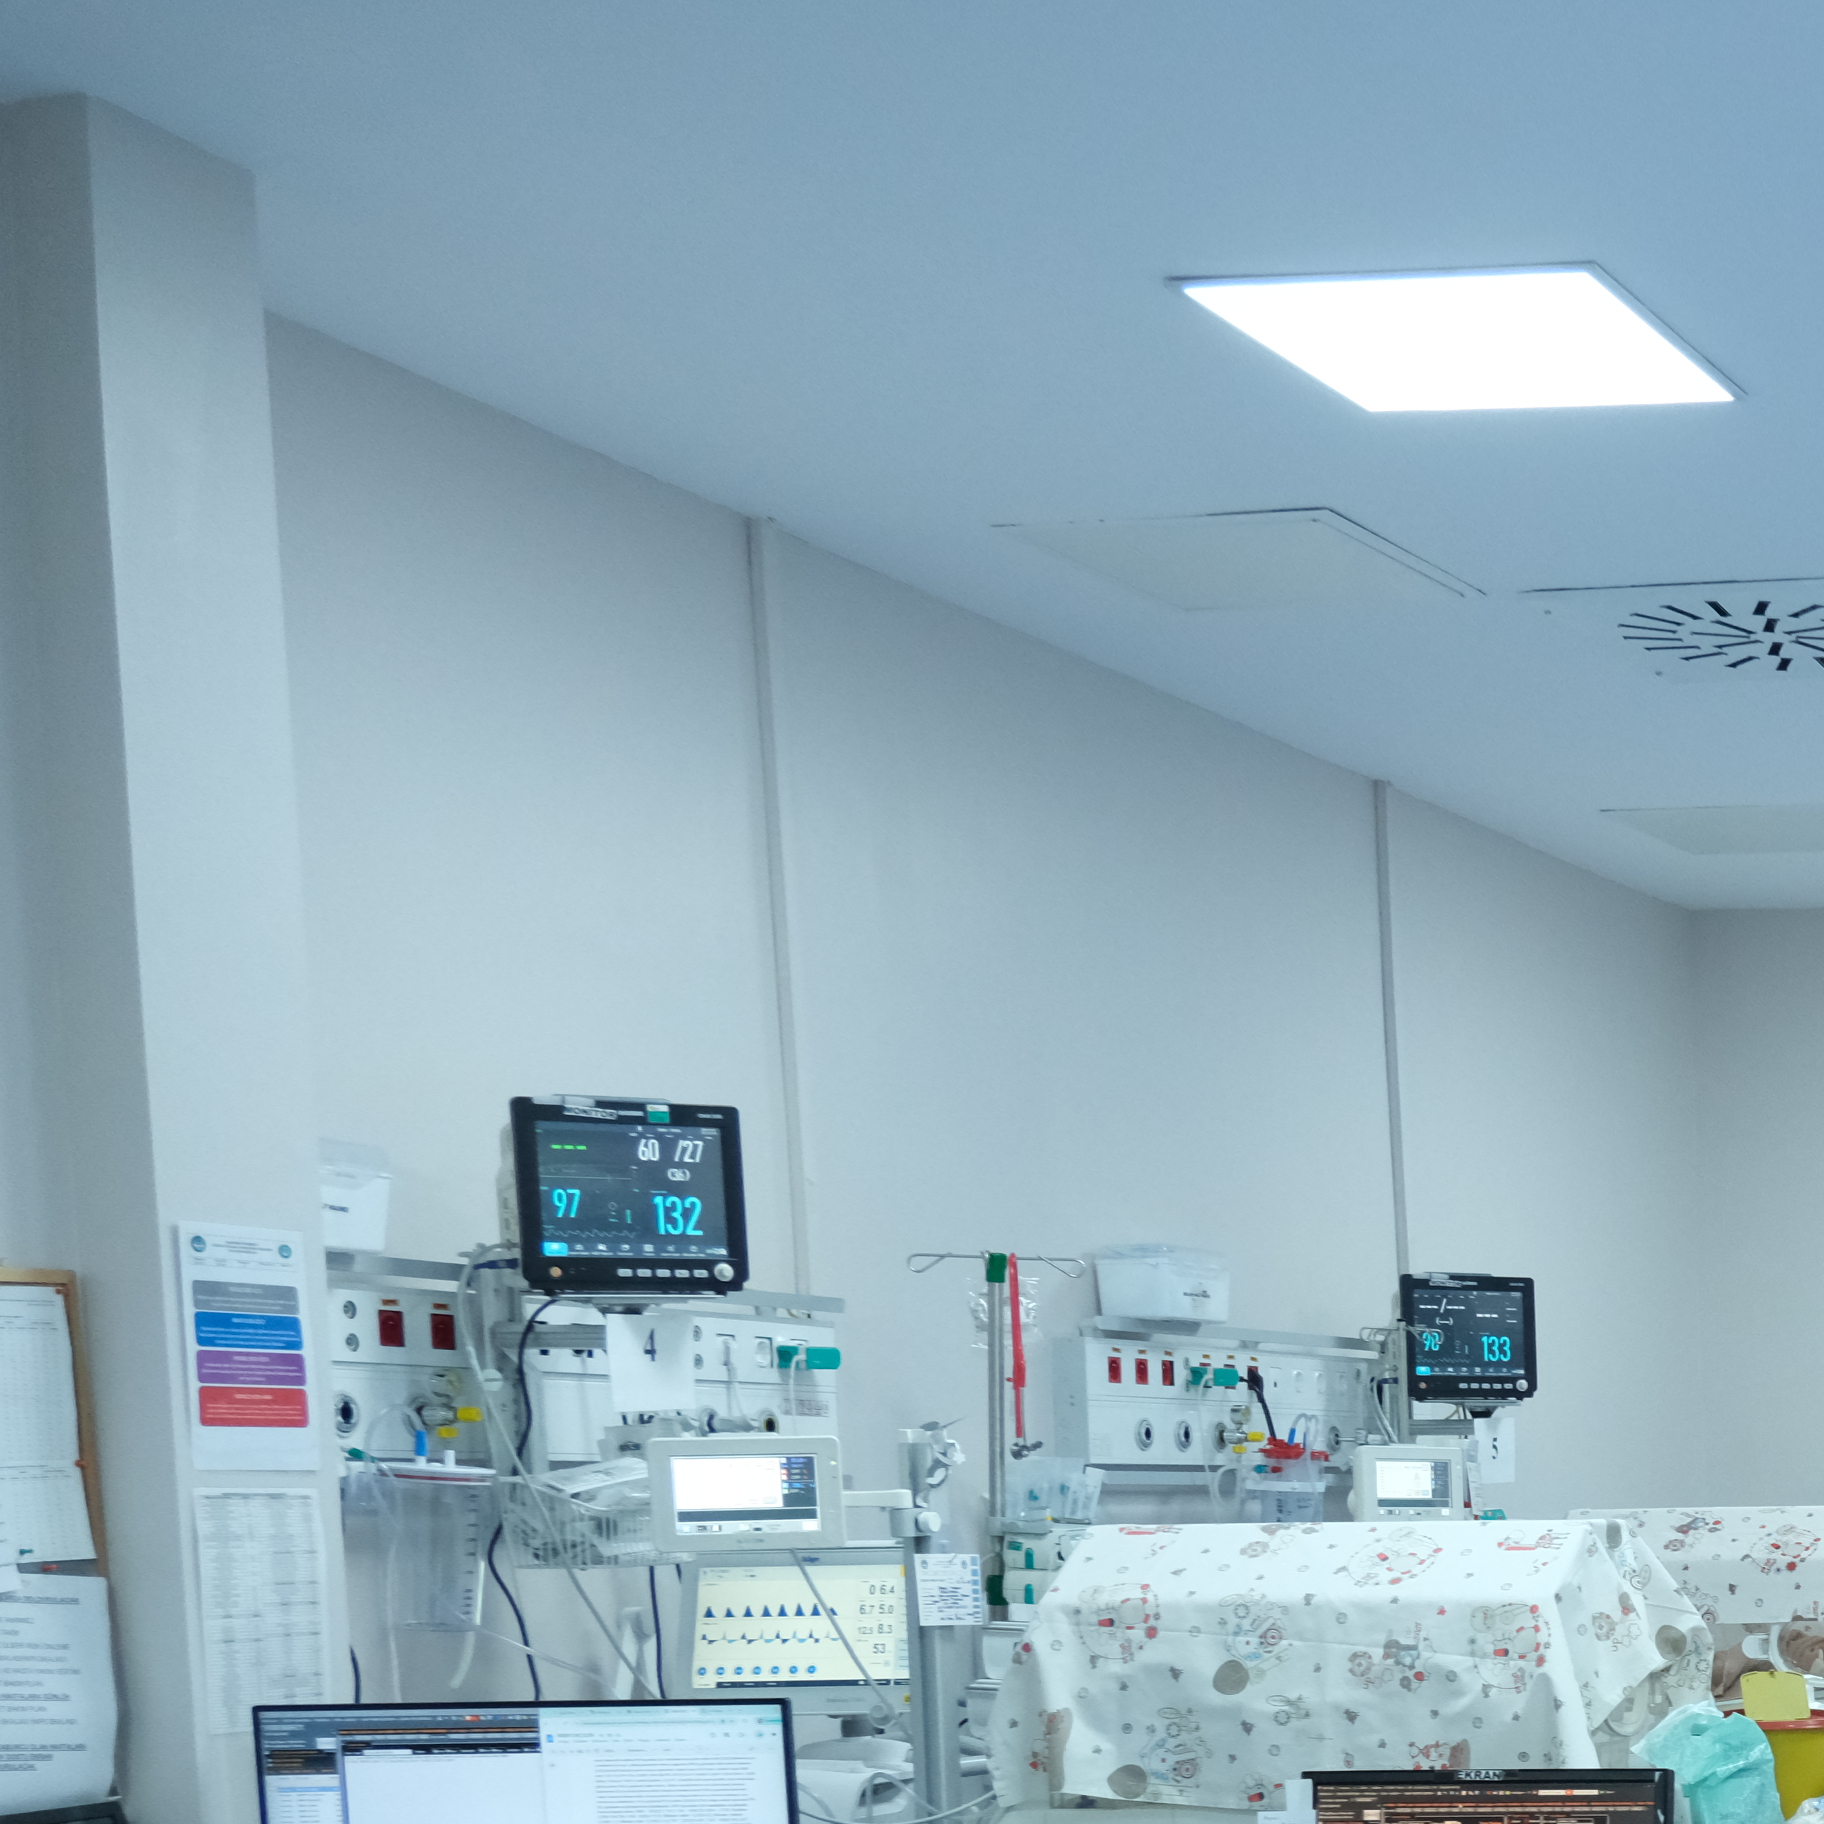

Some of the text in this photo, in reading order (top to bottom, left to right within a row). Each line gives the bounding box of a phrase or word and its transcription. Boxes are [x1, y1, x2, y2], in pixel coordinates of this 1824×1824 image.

[638, 1138, 704, 1163] 60 /27
[552, 1188, 581, 1218] 97
[653, 1195, 704, 1236] 132
[643, 1328, 657, 1362] 4
[1481, 1335, 1511, 1361] 133
[1491, 1437, 1499, 1460] 5
[869, 1584, 895, 1595] 0 6.4
[859, 1603, 893, 1615] 6.7 5.0
[877, 1623, 892, 1635] 8.3
[872, 1643, 886, 1655] 53
[1457, 1769, 1504, 1780] EKRAN
